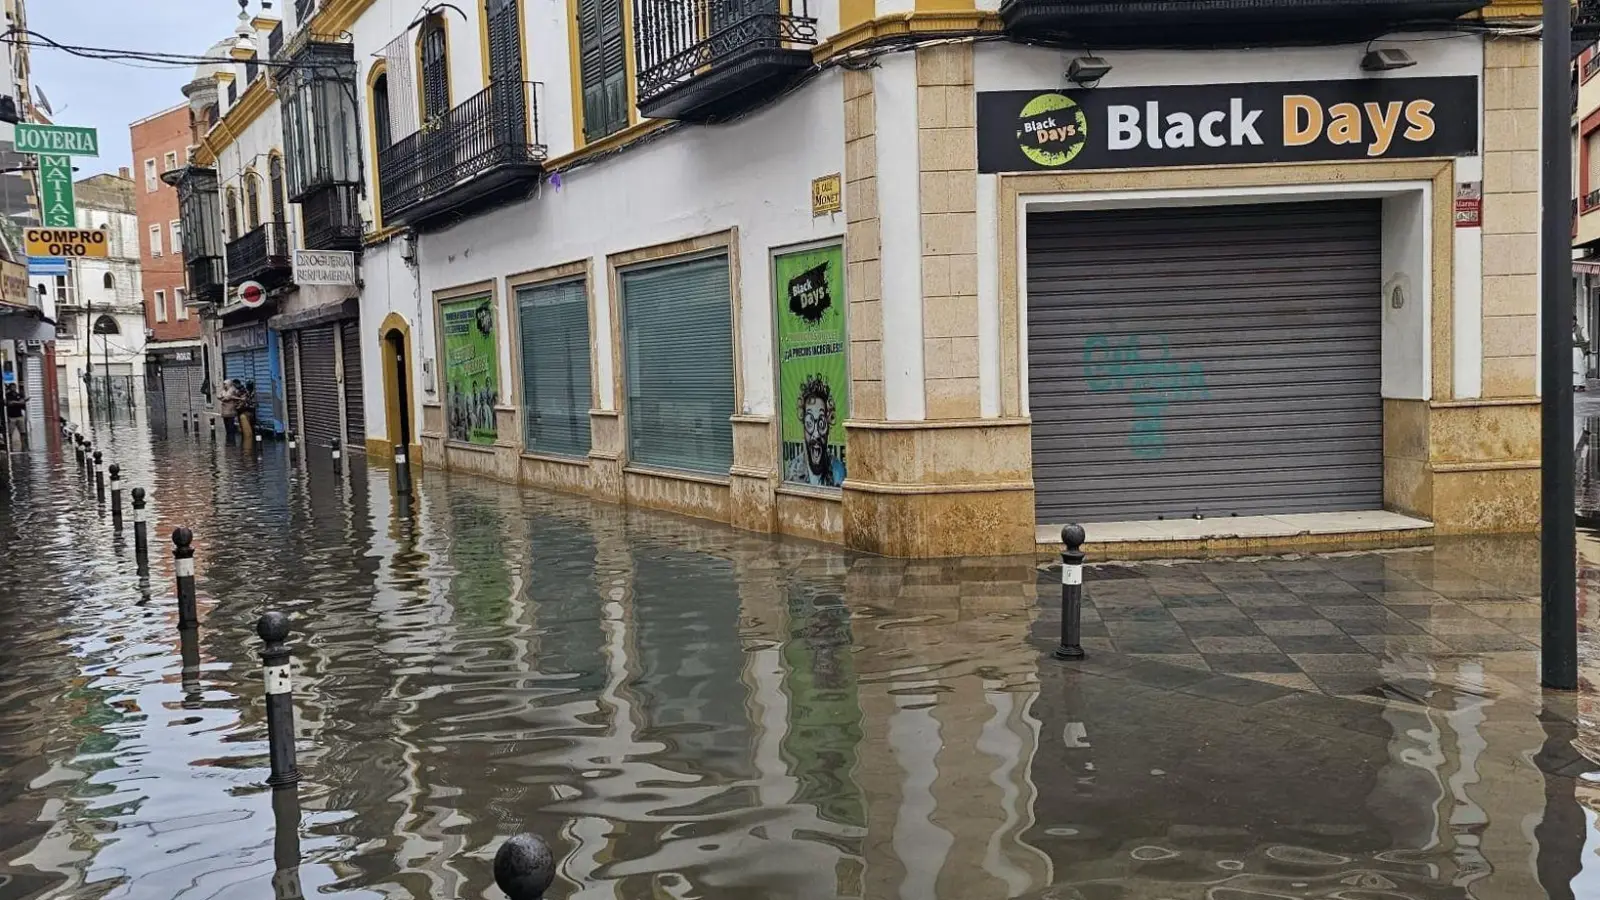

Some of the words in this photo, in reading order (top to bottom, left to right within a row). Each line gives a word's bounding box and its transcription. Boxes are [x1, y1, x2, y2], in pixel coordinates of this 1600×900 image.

[1023, 117, 1057, 133] Black
[1036, 124, 1076, 144] Days
[1107, 97, 1264, 150] Black
[1282, 94, 1436, 156] Days
[18, 128, 95, 151] JOYERIA
[45, 155, 70, 227] MATIAS
[27, 230, 104, 244] COMPRO
[48, 243, 86, 256] ORO
[792, 279, 813, 297] Black
[800, 286, 825, 308] Days
